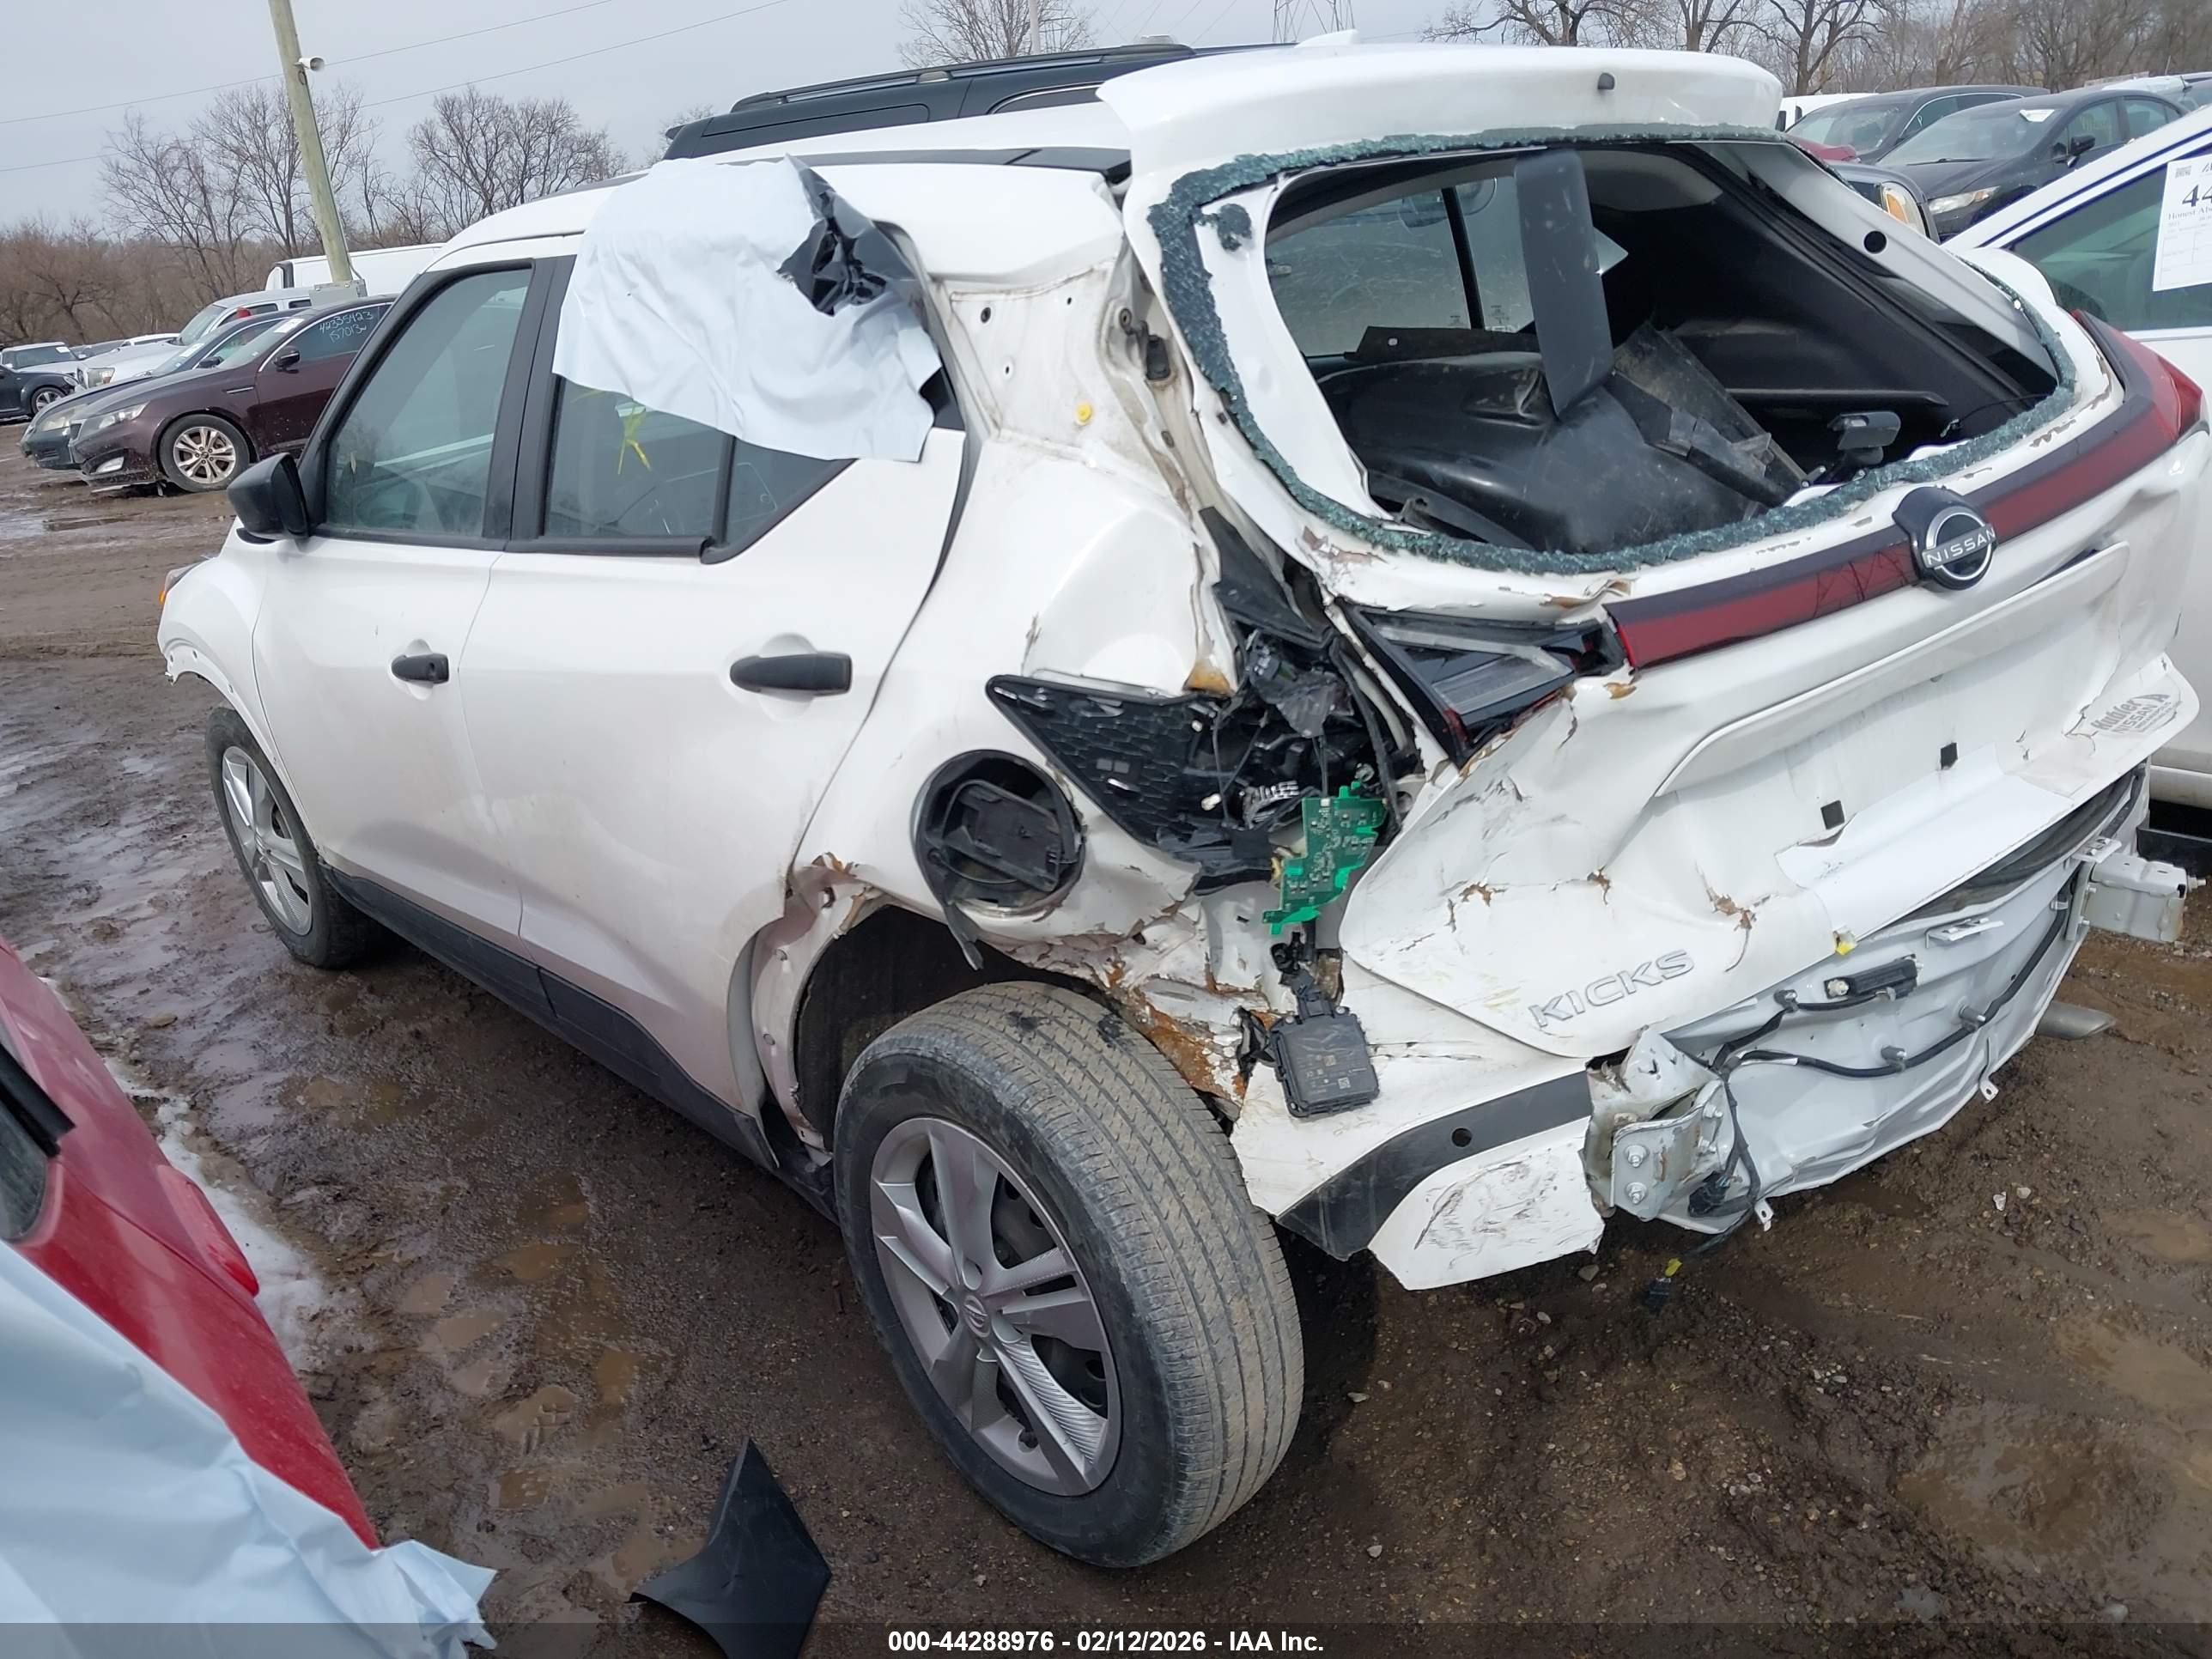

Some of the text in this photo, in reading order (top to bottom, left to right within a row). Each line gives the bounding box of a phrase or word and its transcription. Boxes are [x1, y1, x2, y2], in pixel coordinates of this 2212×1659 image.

[1927, 526, 1996, 565] NISSAN
[2112, 703, 2158, 733] NISSAN
[1528, 949, 1695, 1028] KICKS
